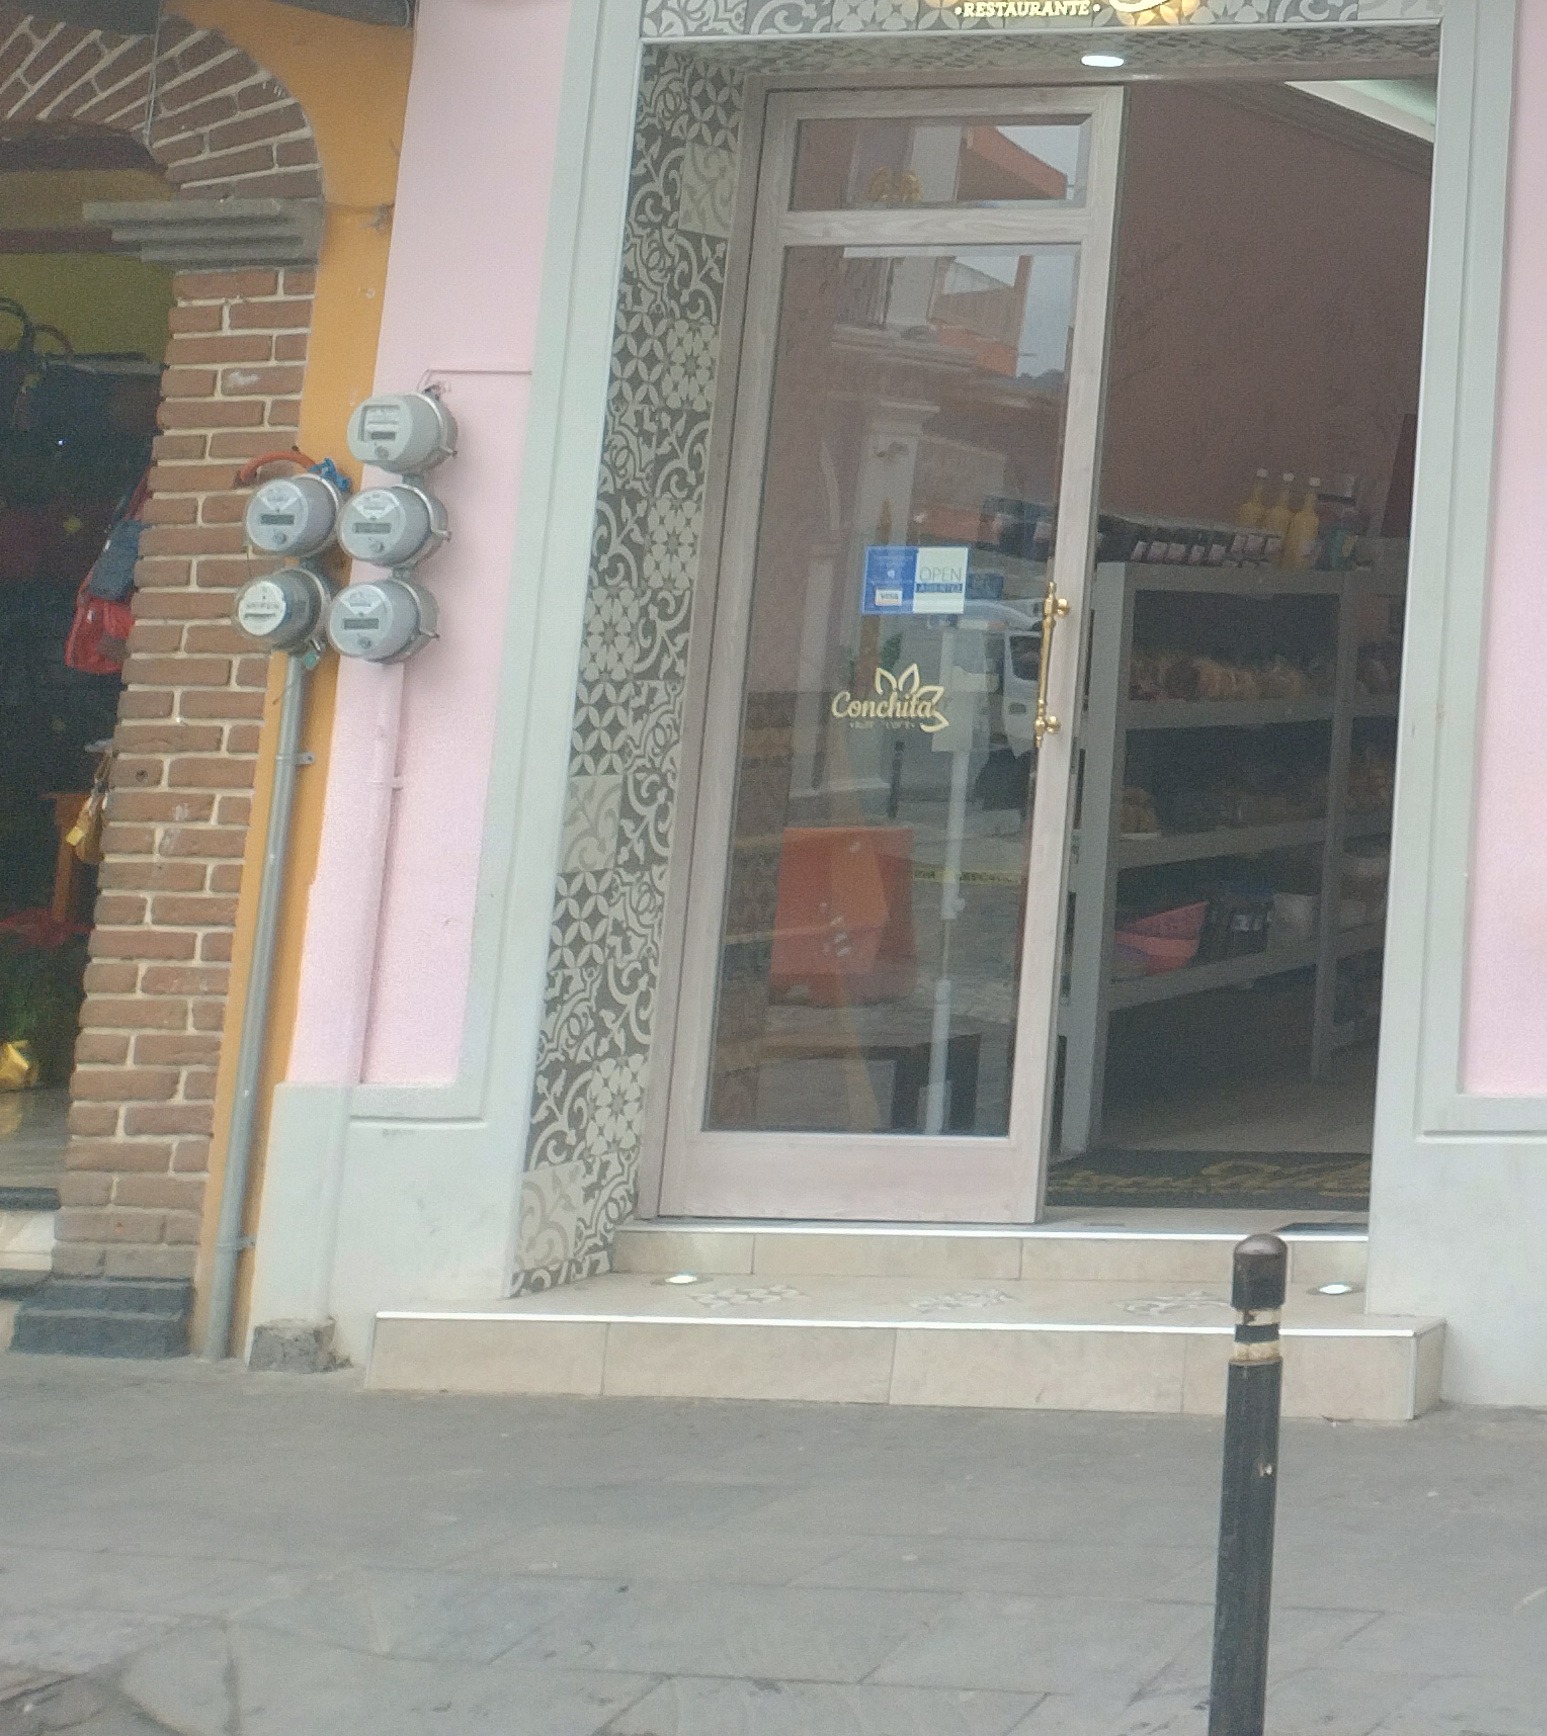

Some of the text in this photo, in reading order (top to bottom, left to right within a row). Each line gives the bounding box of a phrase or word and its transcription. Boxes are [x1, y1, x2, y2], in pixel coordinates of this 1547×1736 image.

[962, 0, 1090, 18] RESTAURANTE
[919, 566, 962, 582] OPEN
[831, 691, 936, 718] Conchita
